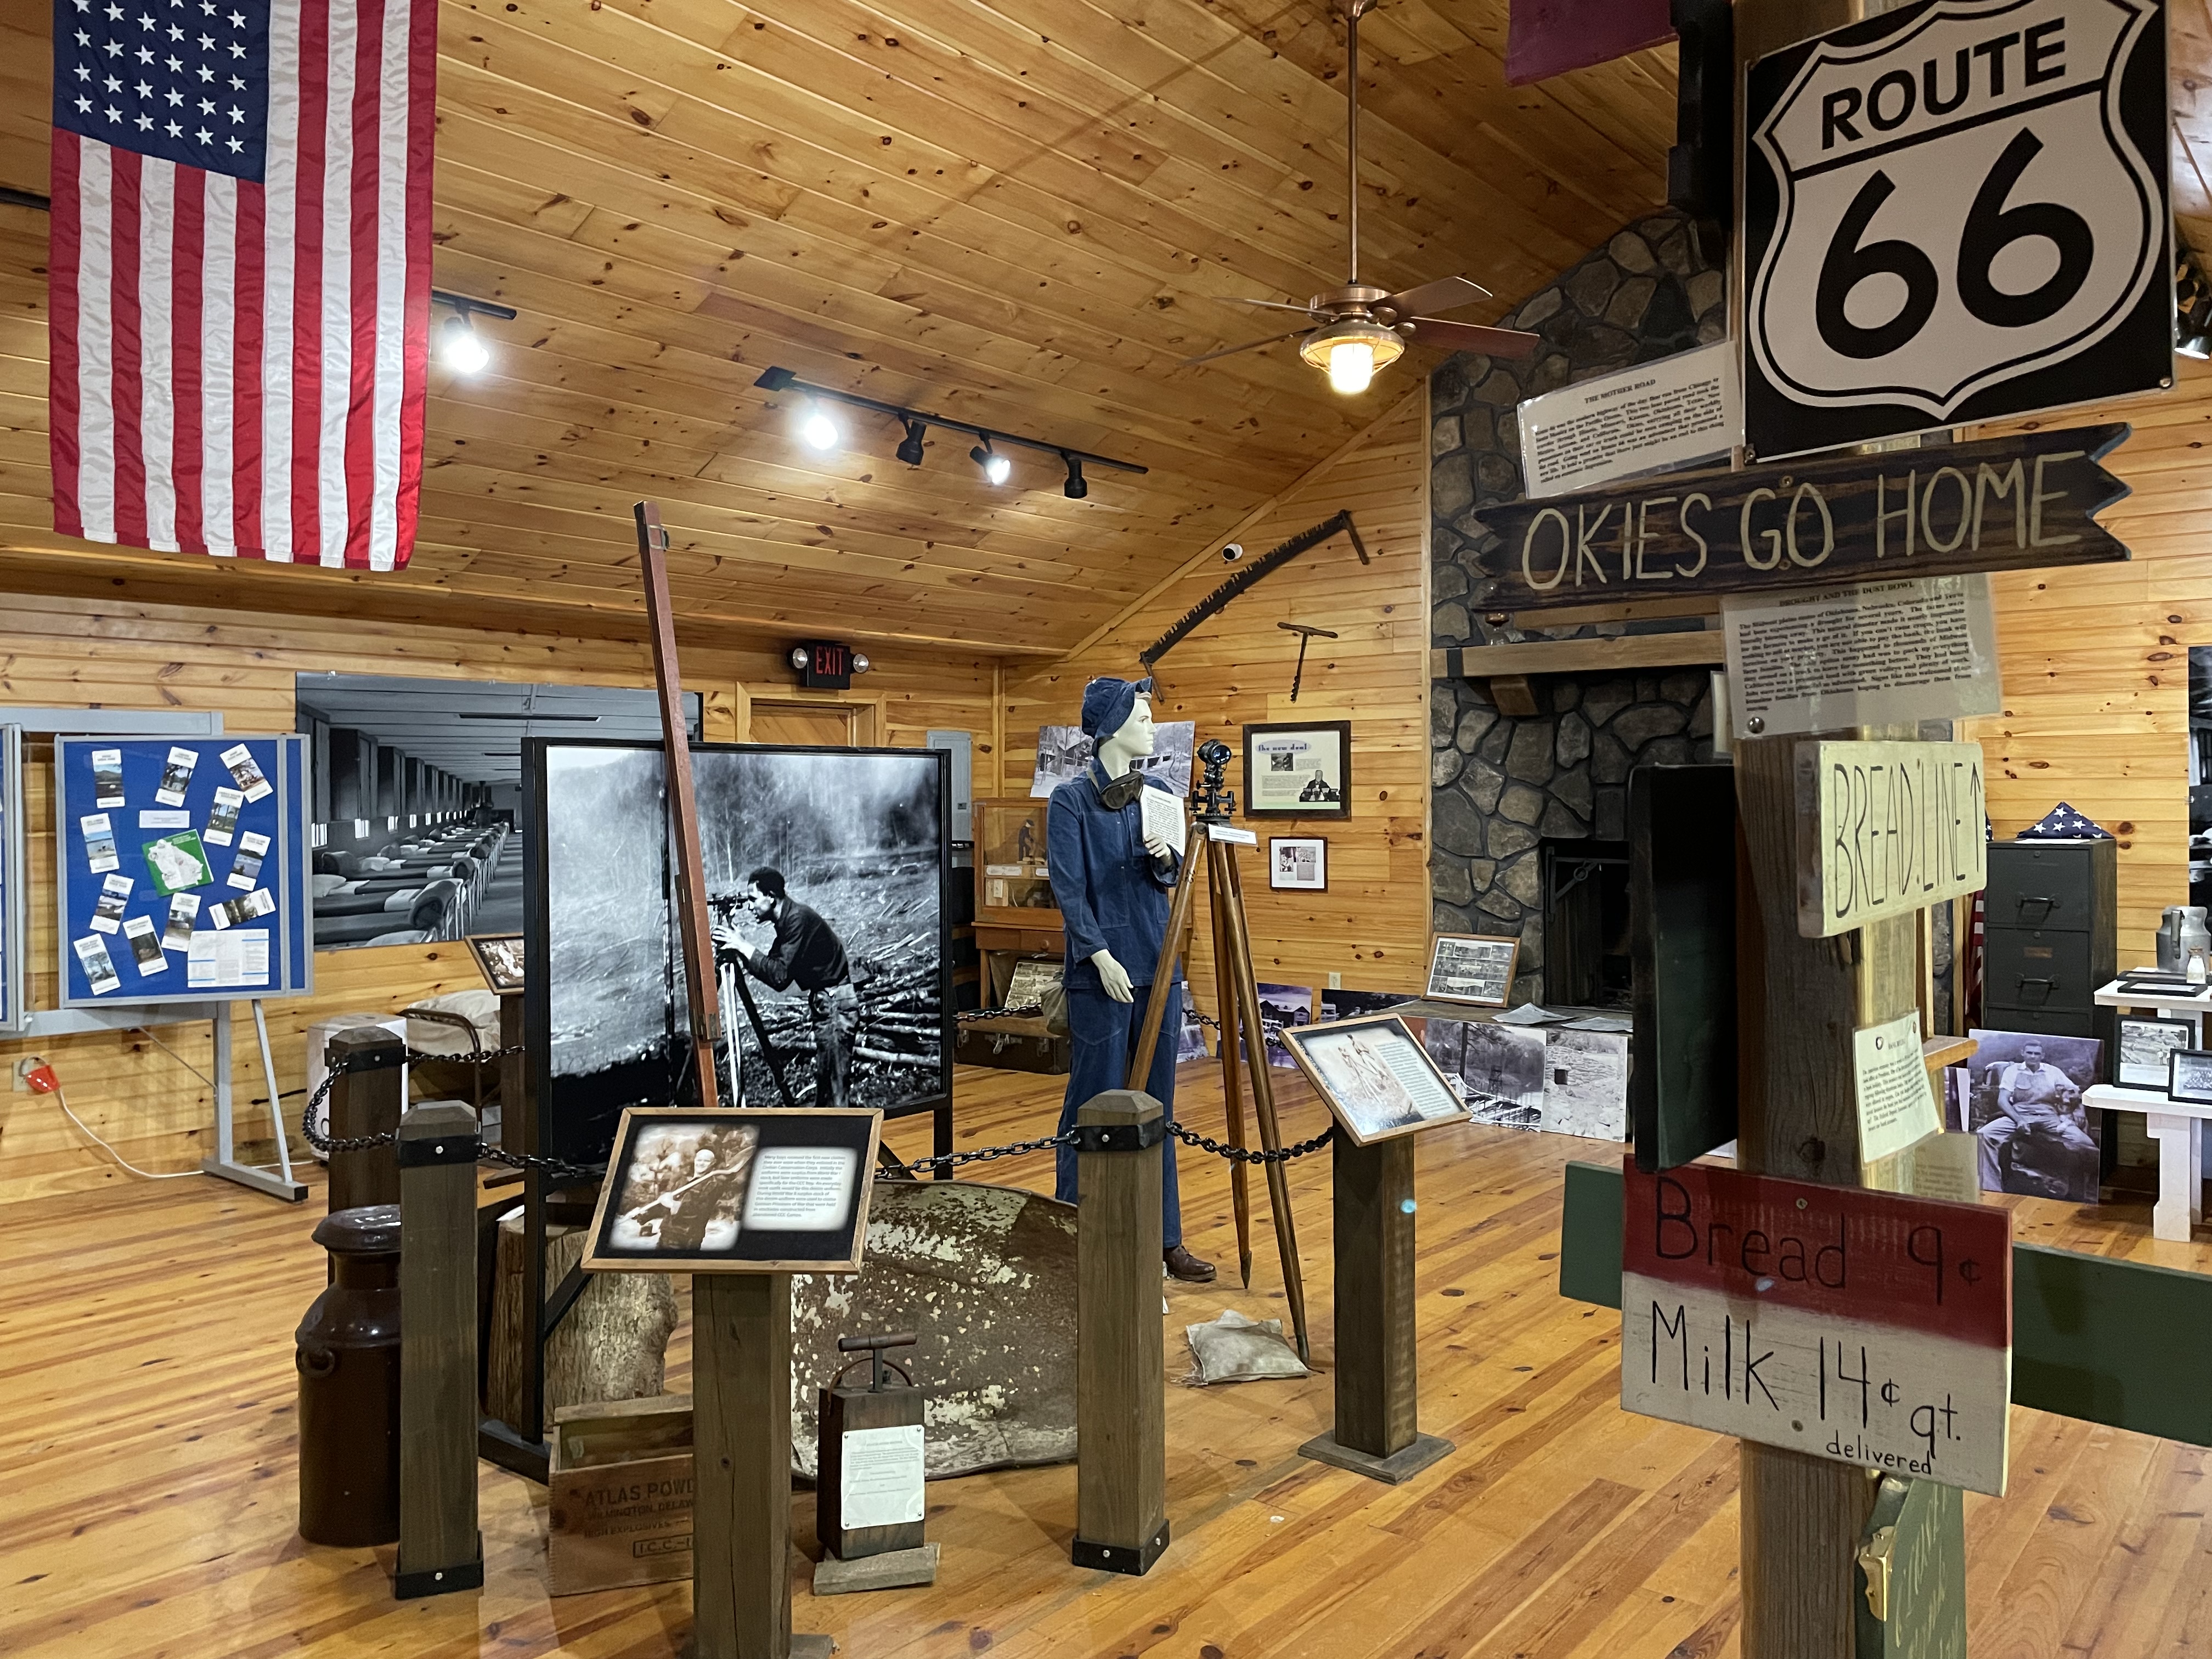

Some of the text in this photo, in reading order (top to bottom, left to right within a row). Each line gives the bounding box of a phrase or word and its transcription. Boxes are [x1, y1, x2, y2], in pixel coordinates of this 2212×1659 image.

[1822, 17, 2066, 149] ROUTE
[1816, 128, 2094, 359] 66
[1584, 379, 1656, 403] THE MOTHER ROAD
[1522, 450, 2087, 591] OKIES GO HOME
[1823, 591, 1840, 600] AND
[1863, 585, 1883, 594] DUST
[1887, 581, 1914, 590] BOWL
[816, 646, 844, 676] EXIT
[1834, 761, 1966, 918] BREAD LINE
[1656, 1176, 1846, 1289] Bread
[1652, 1300, 1780, 1411] Milk
[1910, 1394, 1962, 1460] qt.
[1826, 1430, 1933, 1476] delivered
[585, 1486, 641, 1507] ATLAS
[611, 1520, 672, 1534] EXPLOSIVES
